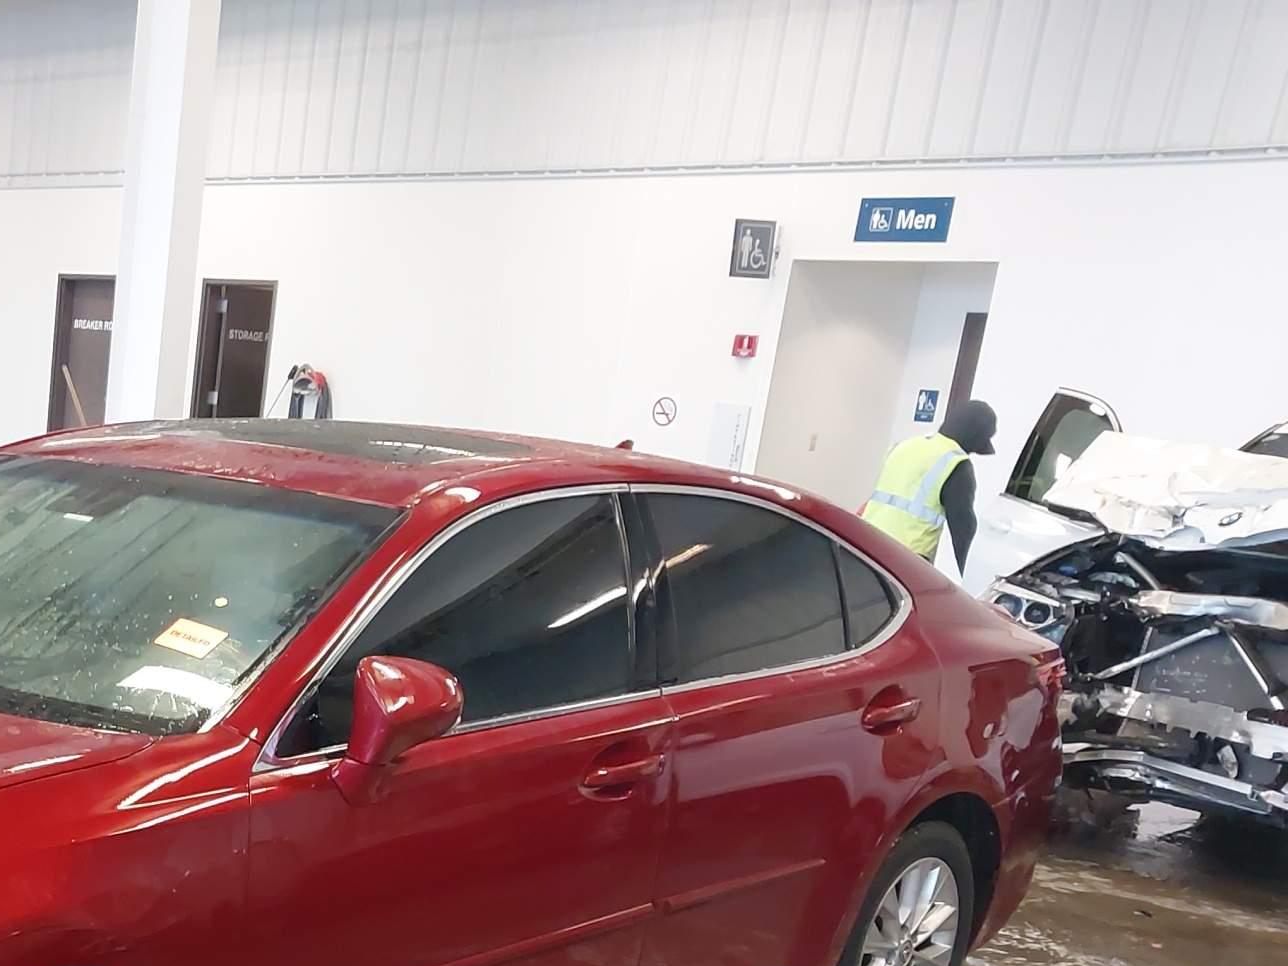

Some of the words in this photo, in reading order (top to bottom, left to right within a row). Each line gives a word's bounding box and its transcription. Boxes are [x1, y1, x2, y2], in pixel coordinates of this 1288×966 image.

[895, 209, 937, 230] Men
[74, 318, 103, 331] BREAKER
[228, 328, 264, 342] STORAGE
